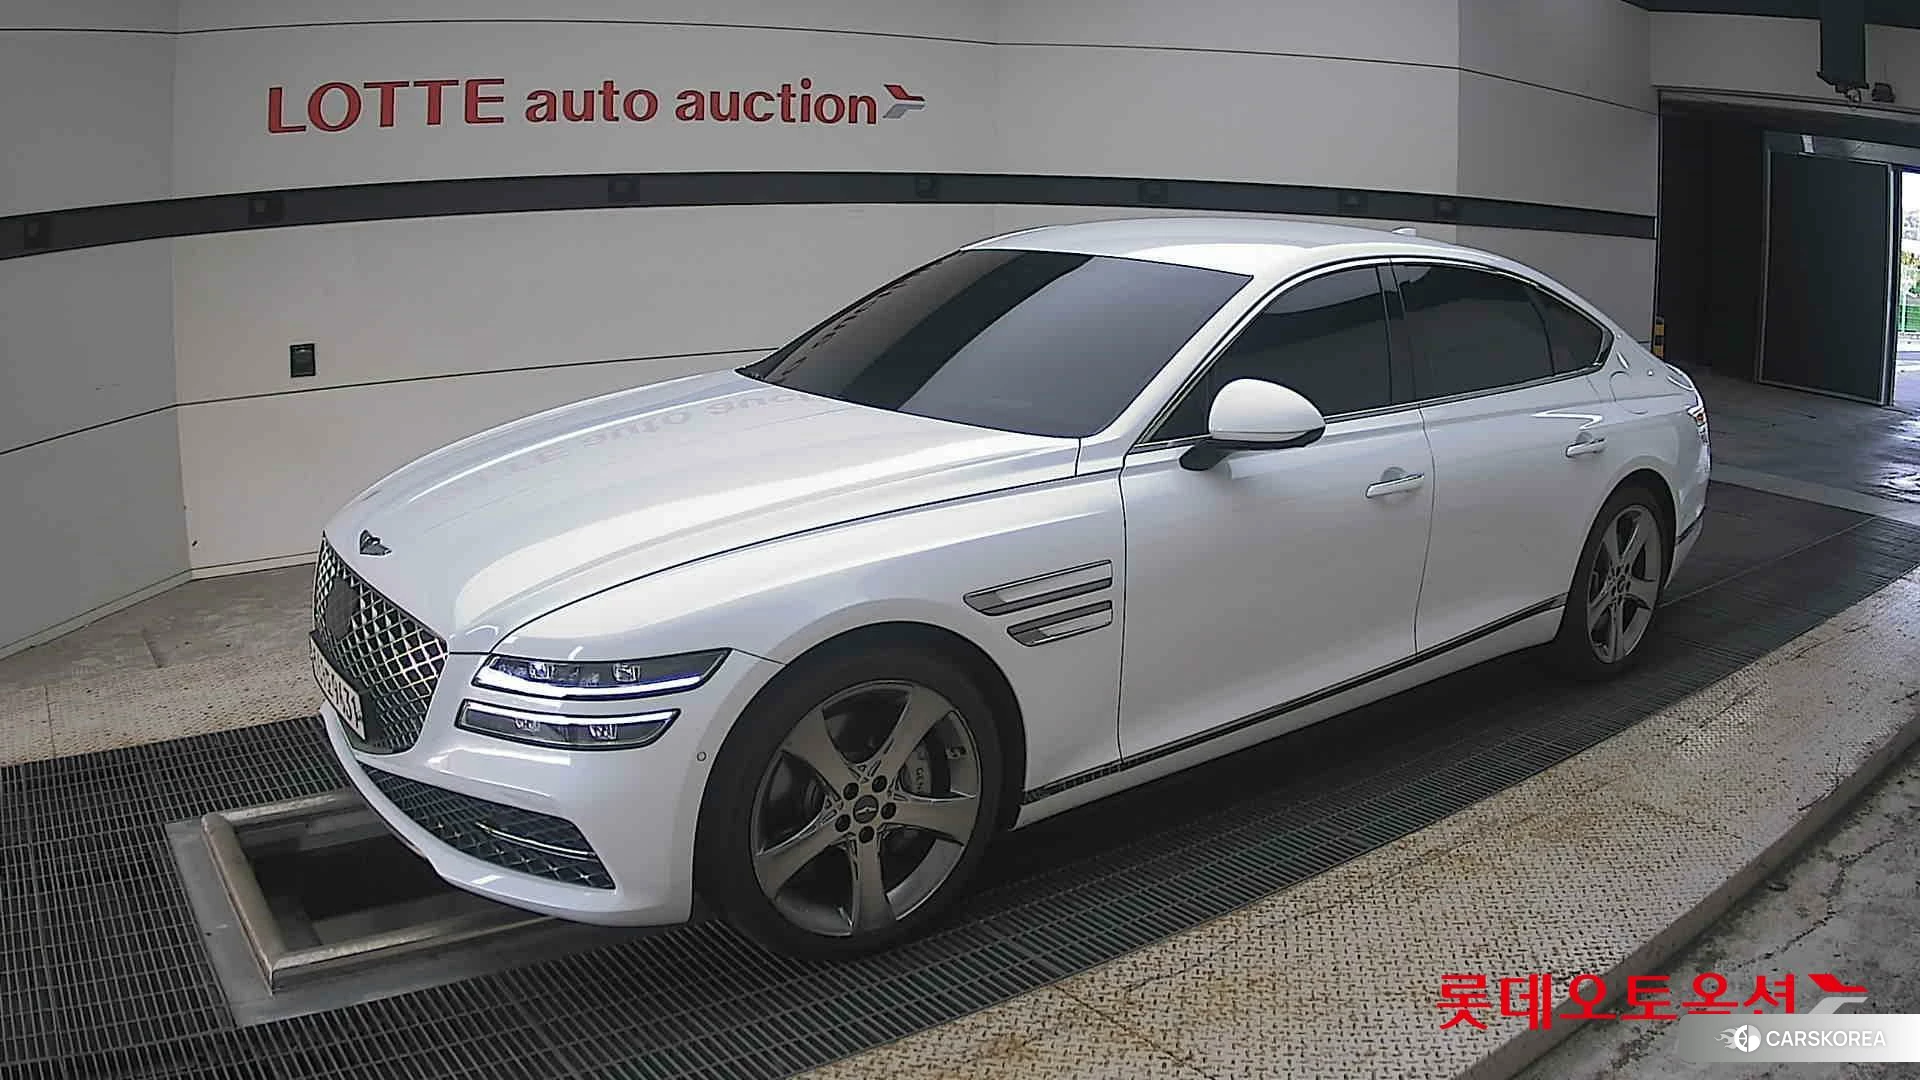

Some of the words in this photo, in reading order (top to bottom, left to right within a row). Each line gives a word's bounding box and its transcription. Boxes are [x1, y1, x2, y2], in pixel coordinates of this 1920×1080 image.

[268, 79, 504, 133] LOTTE
[525, 80, 657, 123] auto
[675, 78, 877, 124] auction
